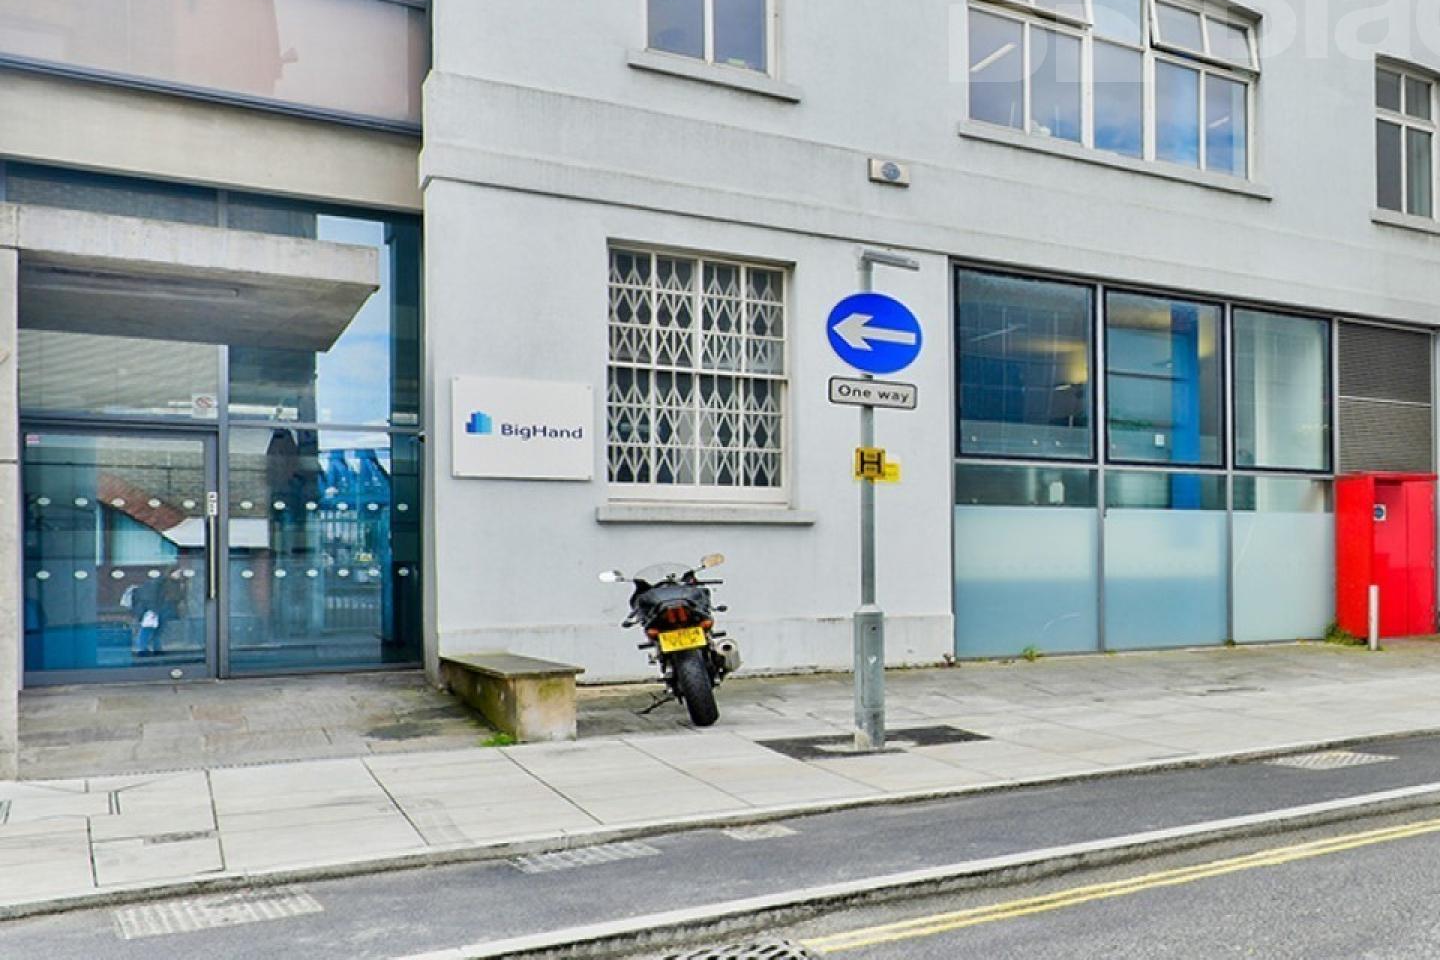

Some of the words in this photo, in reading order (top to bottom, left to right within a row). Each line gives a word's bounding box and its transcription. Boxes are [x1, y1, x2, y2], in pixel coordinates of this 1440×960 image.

[838, 384, 872, 398] One
[878, 390, 910, 403] way
[500, 422, 584, 441] BigHand
